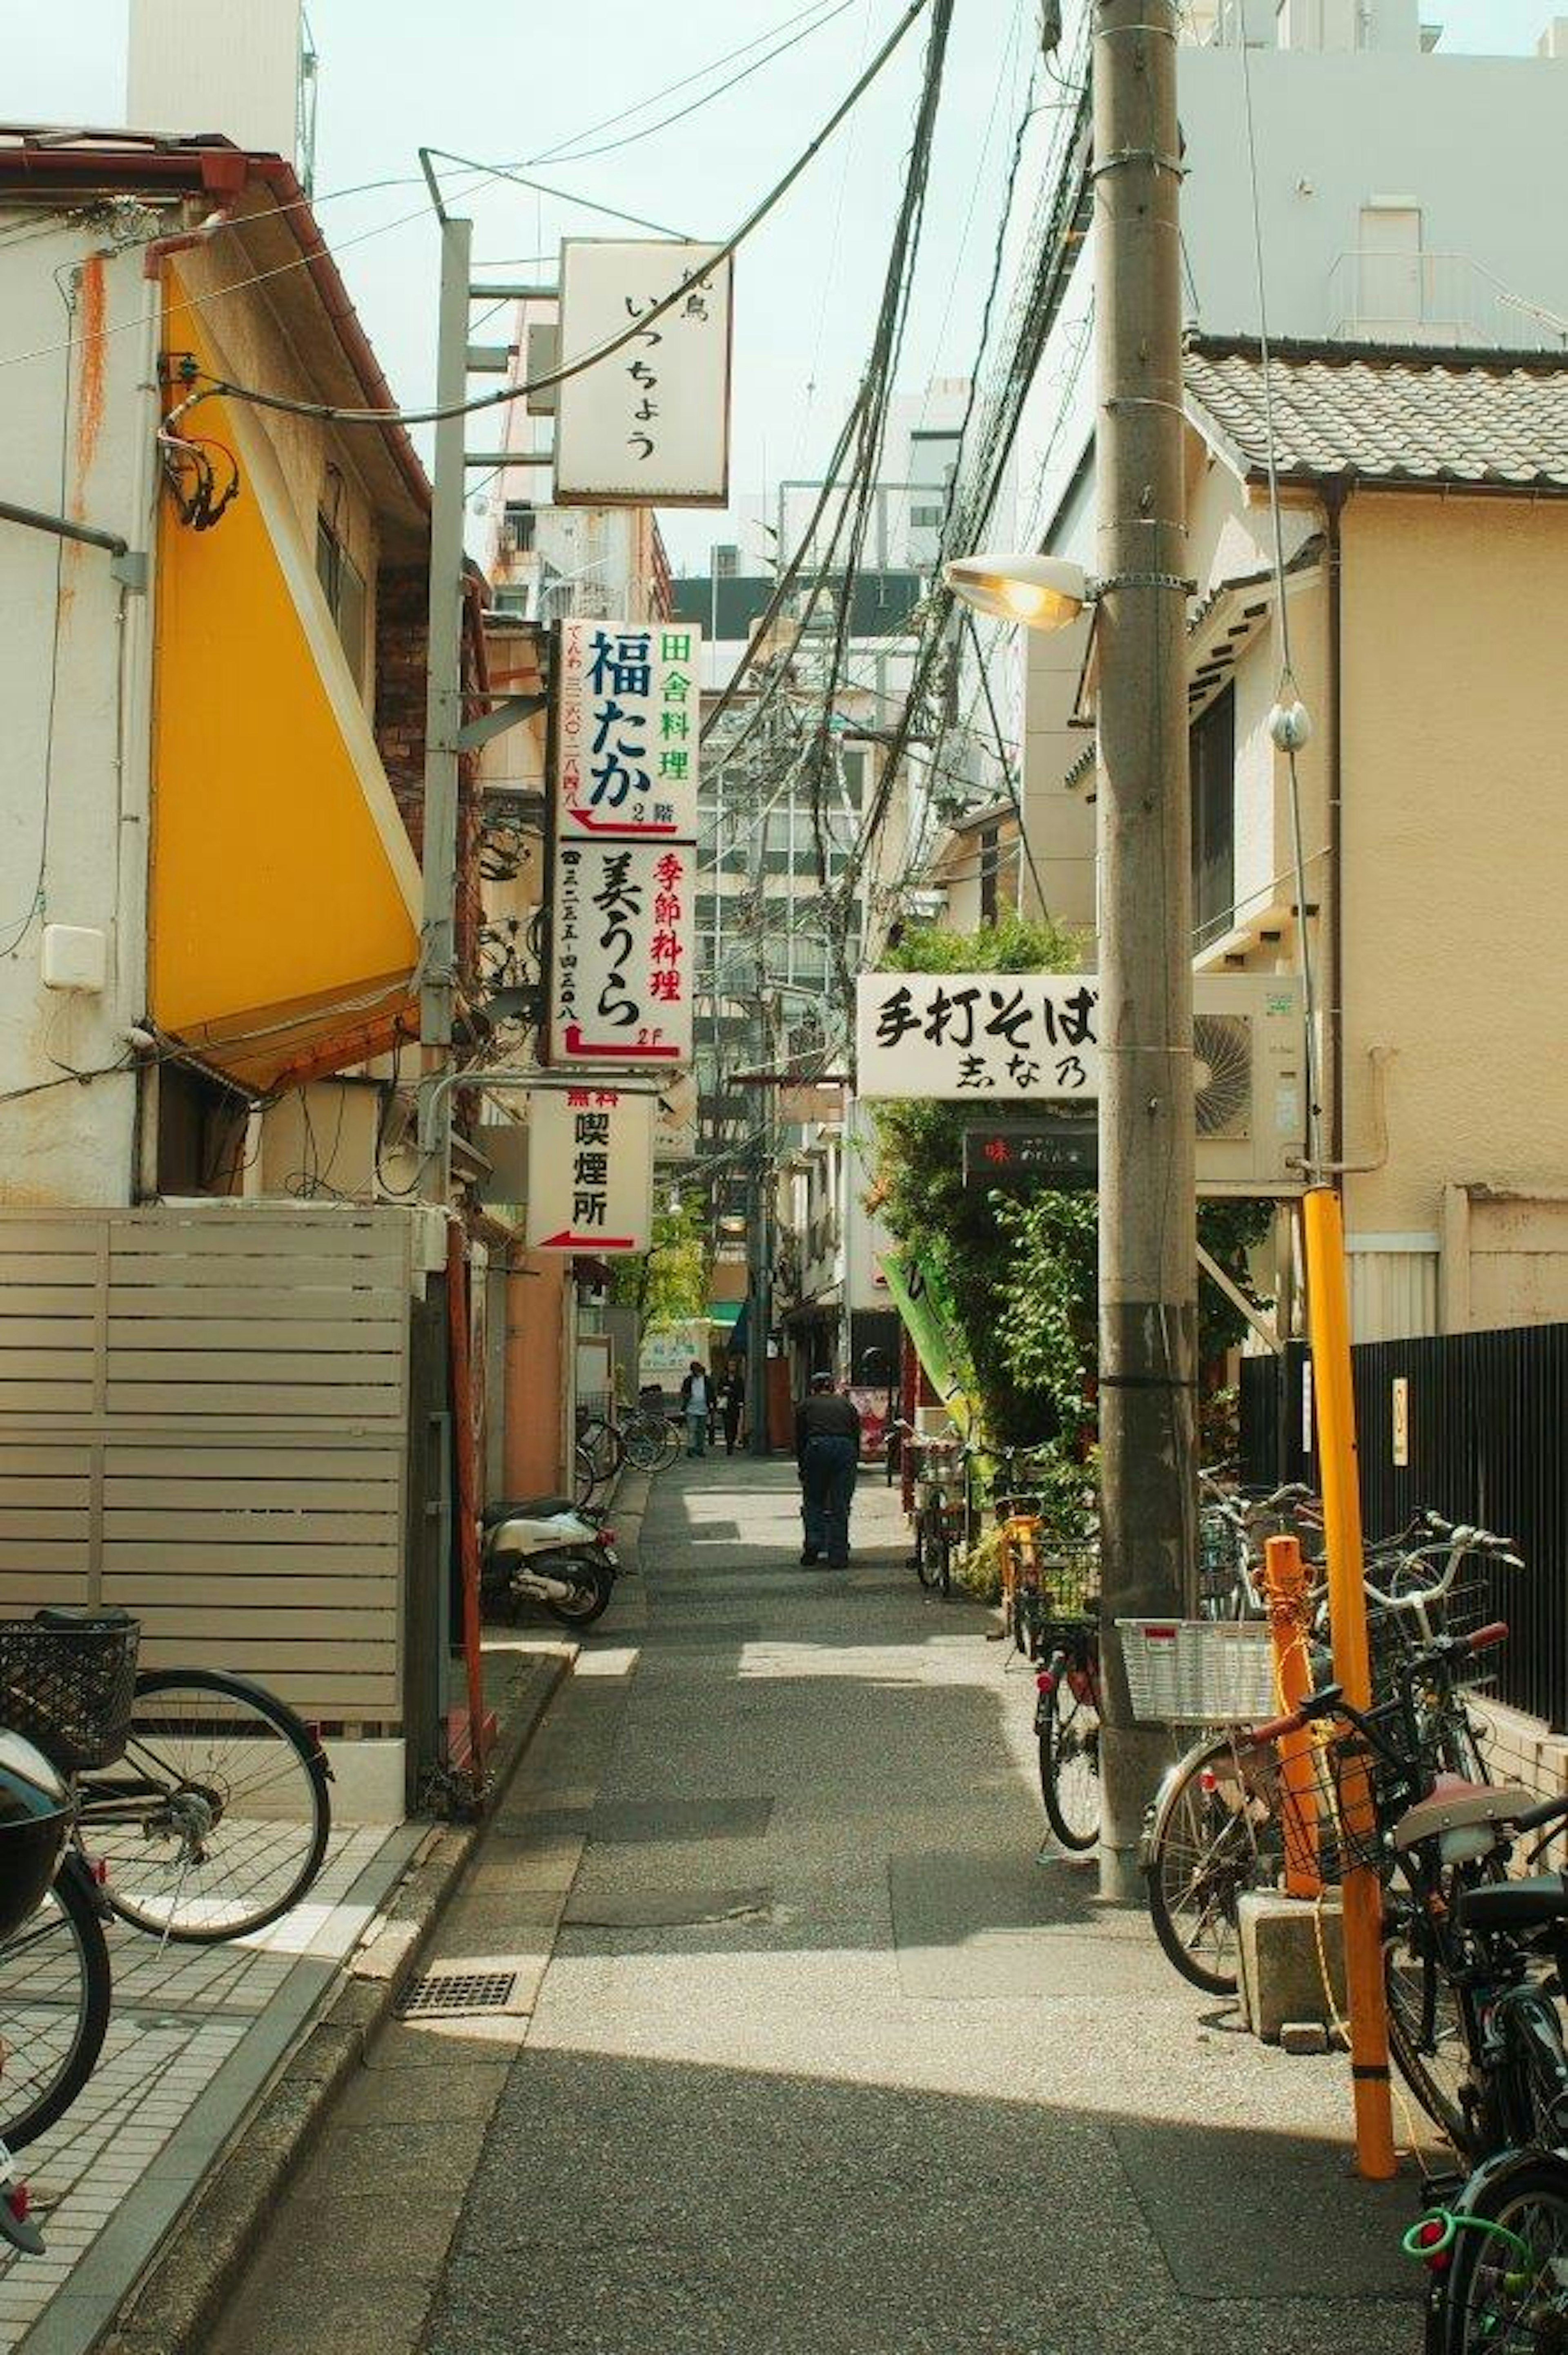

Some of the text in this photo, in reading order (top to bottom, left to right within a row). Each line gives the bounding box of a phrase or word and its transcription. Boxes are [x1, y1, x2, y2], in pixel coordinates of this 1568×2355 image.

[585, 631, 651, 807] 福たか
[658, 633, 691, 779] 田舎料理
[633, 803, 675, 823] 2階
[593, 851, 641, 1026] 美うら
[650, 853, 683, 1001] 季節料理
[637, 1028, 662, 1044] 2F
[877, 987, 1099, 1048] 手打そば
[568, 1086, 618, 1107] 無料
[572, 1113, 608, 1225] 喫煙所
